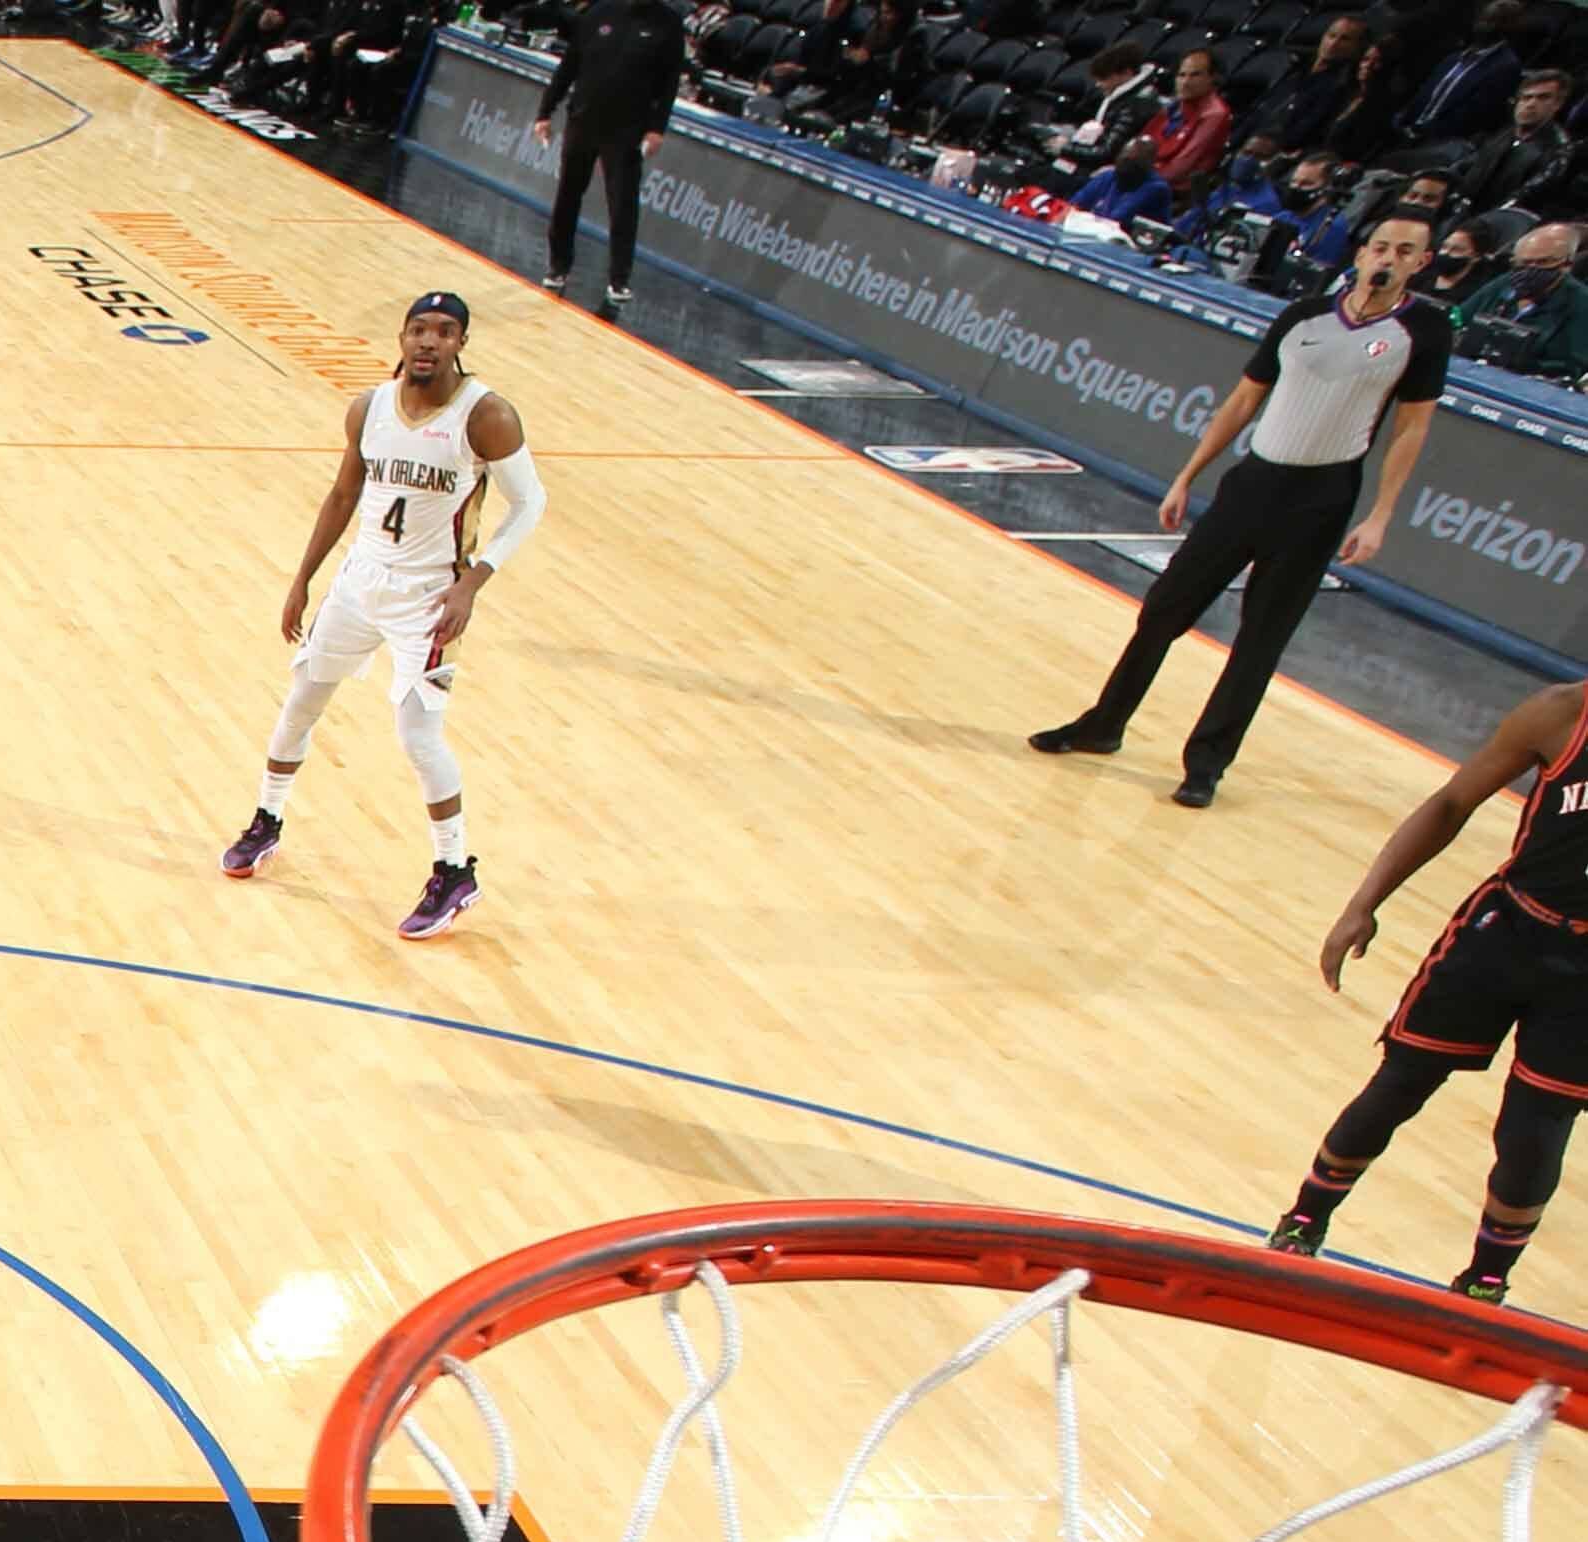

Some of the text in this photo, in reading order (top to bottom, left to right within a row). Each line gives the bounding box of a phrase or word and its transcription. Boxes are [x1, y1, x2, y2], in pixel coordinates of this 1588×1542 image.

[28, 246, 175, 319] CHASE
[639, 169, 674, 213] 5G
[719, 199, 839, 282] Wideband
[825, 246, 855, 289] is
[848, 254, 912, 313] here
[904, 277, 939, 325] in
[930, 287, 1060, 375] Madison
[1054, 337, 1176, 423] Square
[388, 459, 459, 495] ORLEANS
[382, 495, 409, 545] 4
[1408, 486, 1586, 585] verizon
